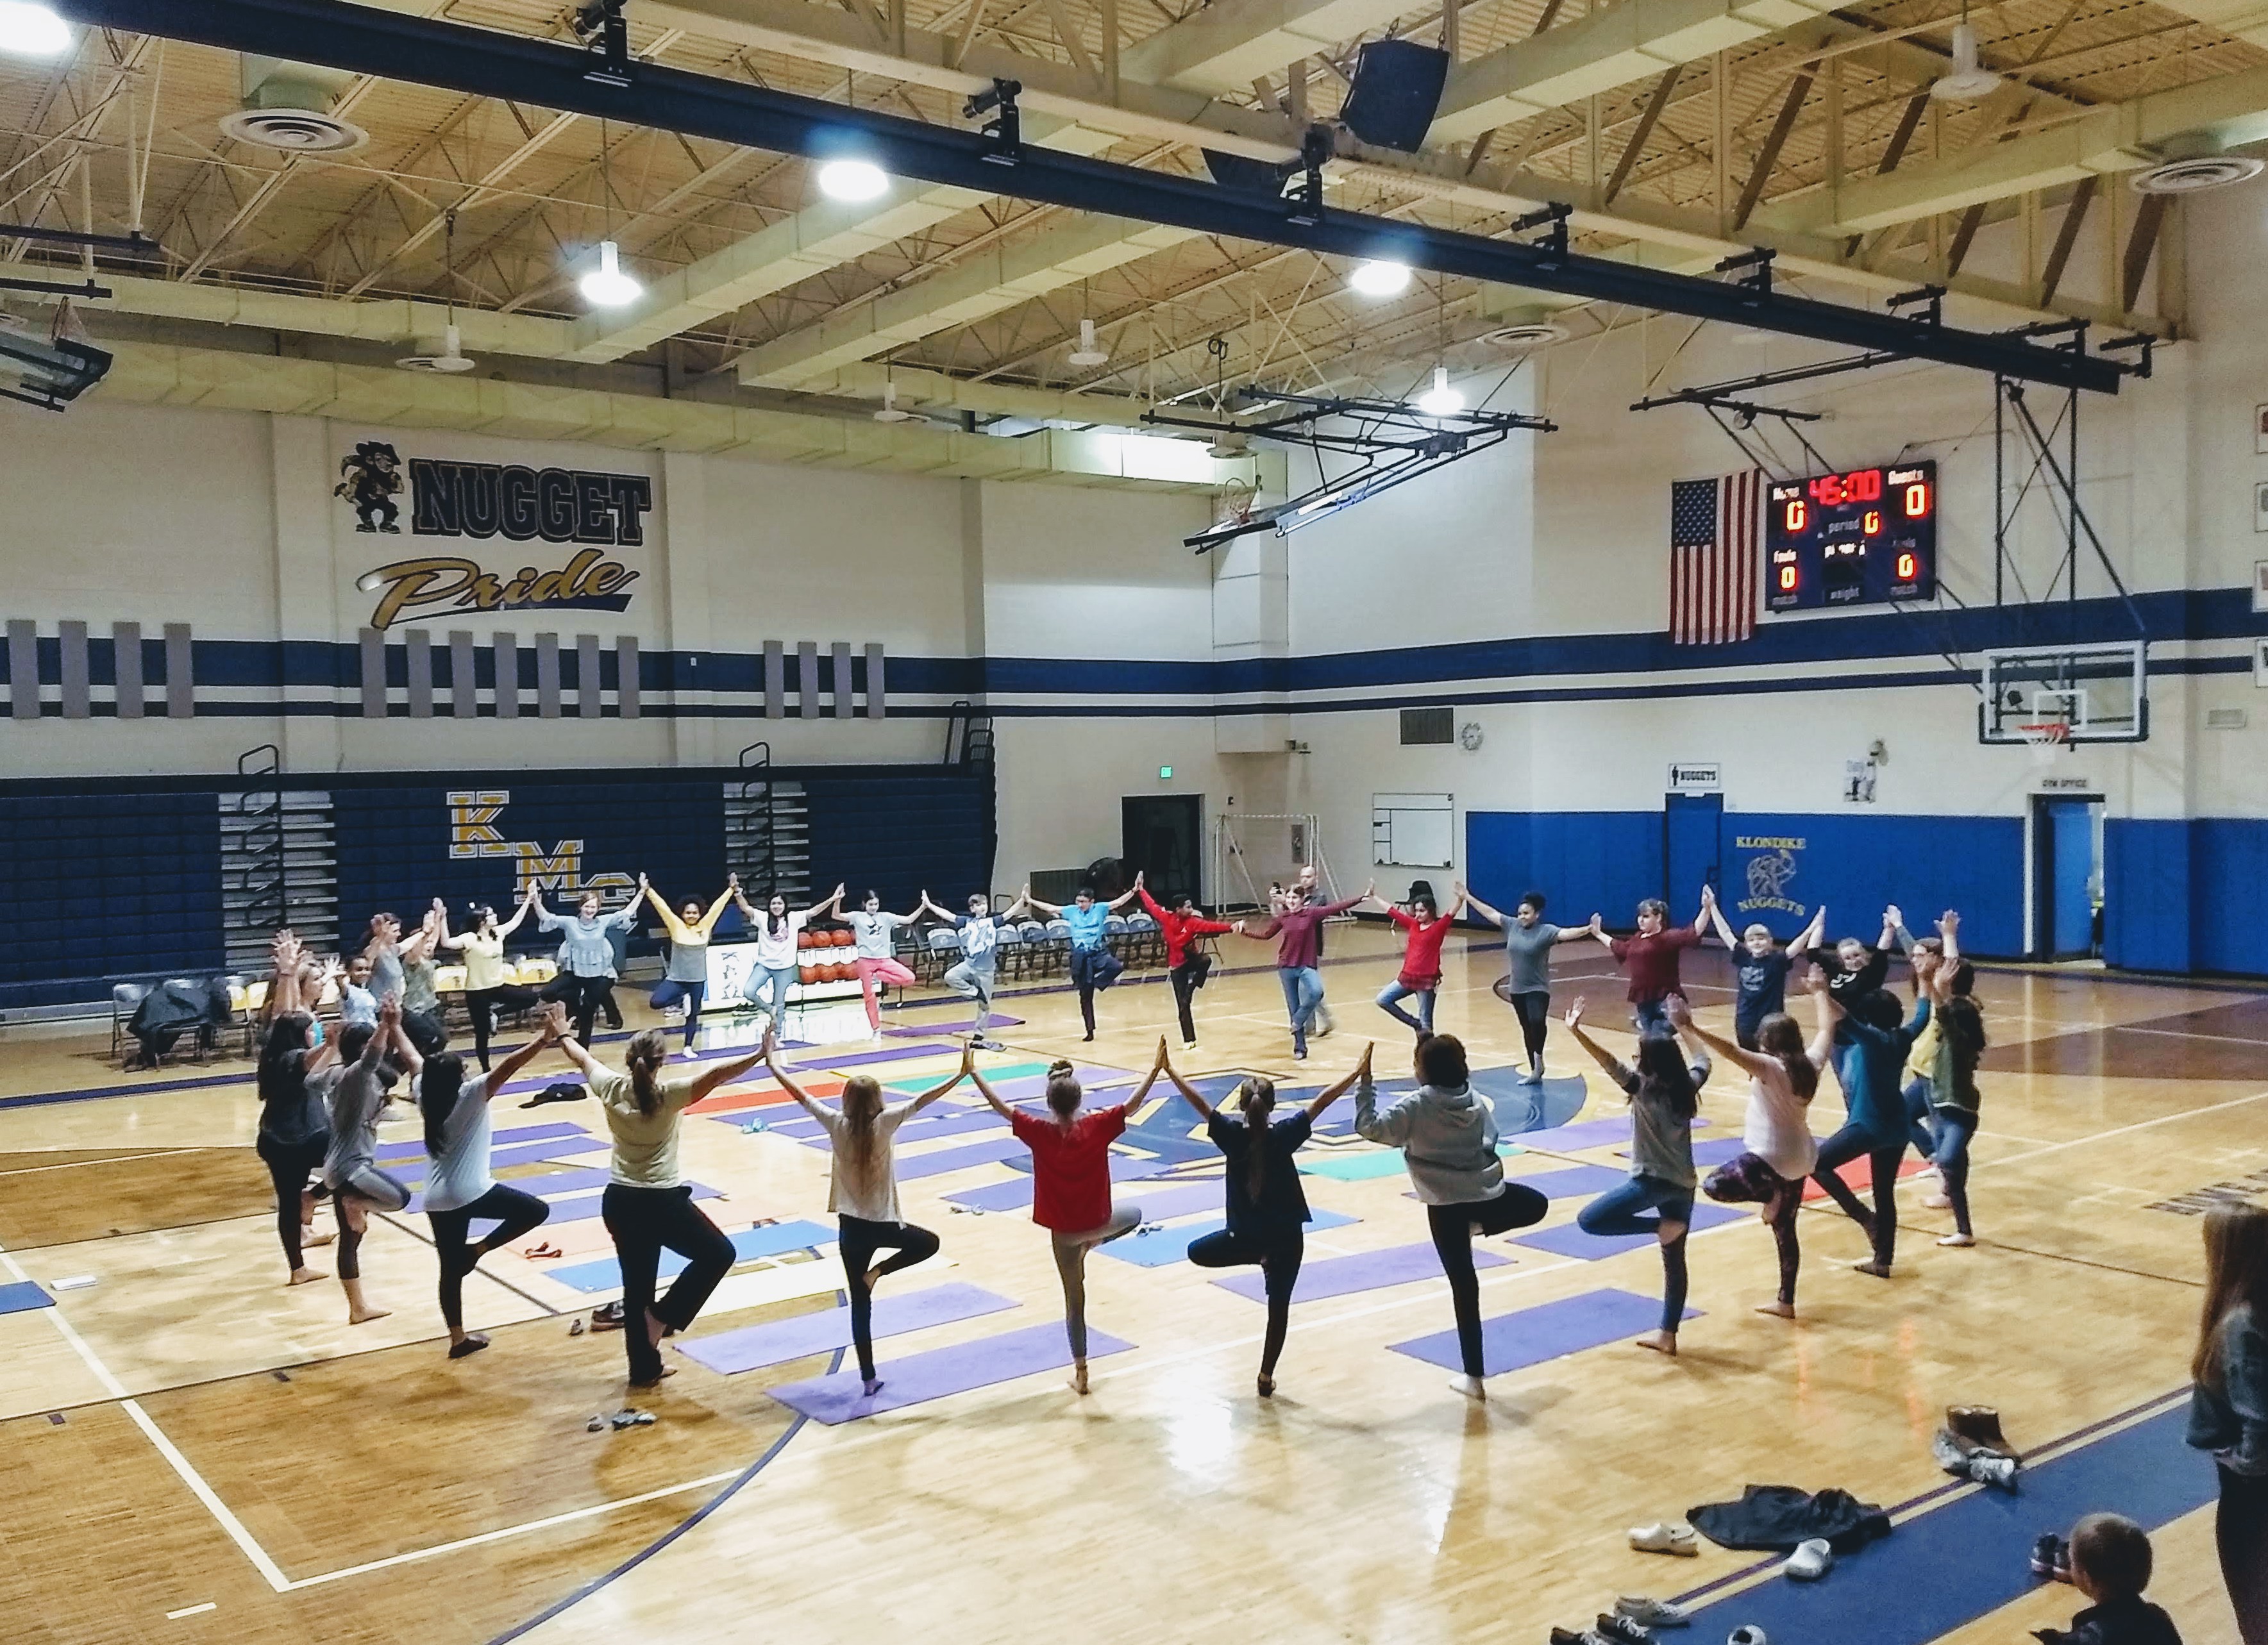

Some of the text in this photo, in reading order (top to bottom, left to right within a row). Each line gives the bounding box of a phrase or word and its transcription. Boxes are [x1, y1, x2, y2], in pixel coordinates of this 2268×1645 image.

[408, 458, 651, 546] NUGGET
[1906, 484, 1925, 515] 0
[1786, 500, 1804, 531] 0
[355, 548, 640, 631] Pride
[1781, 566, 1795, 589] 0
[1736, 836, 1806, 849] KLONDIKE
[1737, 897, 1806, 916] NUGGETS
